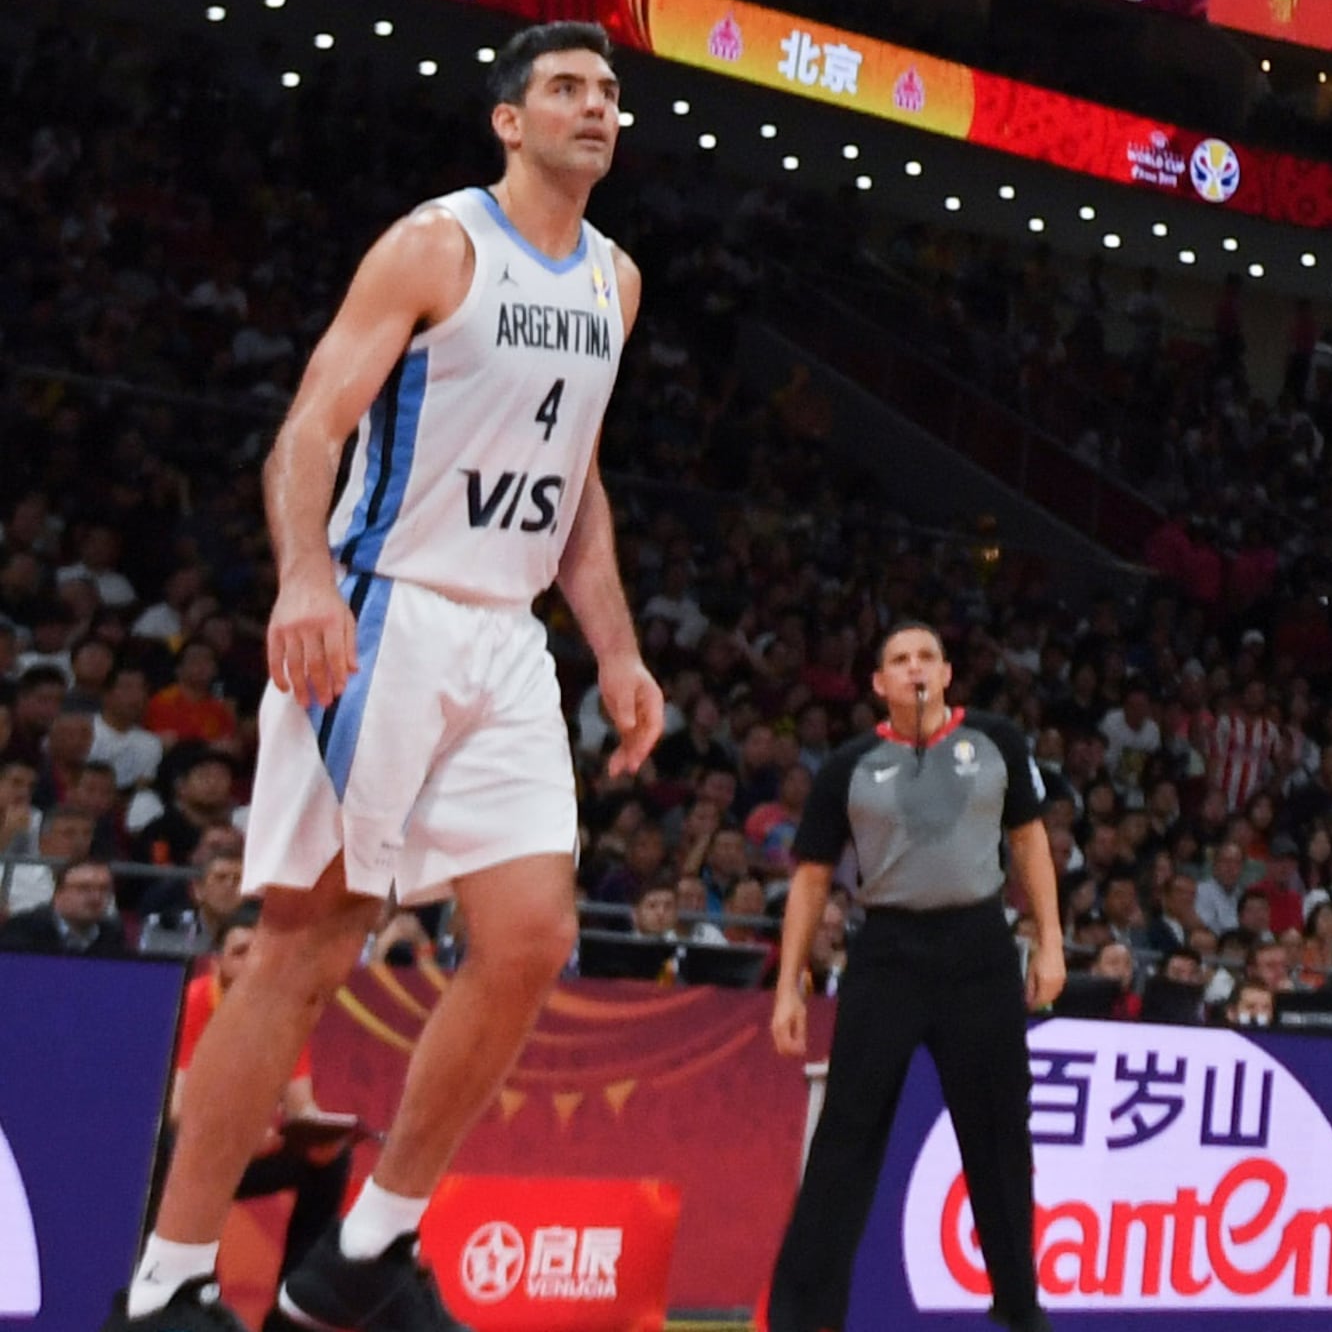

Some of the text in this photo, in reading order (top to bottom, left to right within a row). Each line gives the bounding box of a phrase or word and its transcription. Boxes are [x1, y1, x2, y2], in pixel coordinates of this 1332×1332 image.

[776, 29, 864, 96] 北京
[496, 303, 611, 361] ARGENTINA
[535, 378, 565, 442] 4
[459, 468, 566, 536] VIS
[1030, 1050, 1275, 1150] 百岁山
